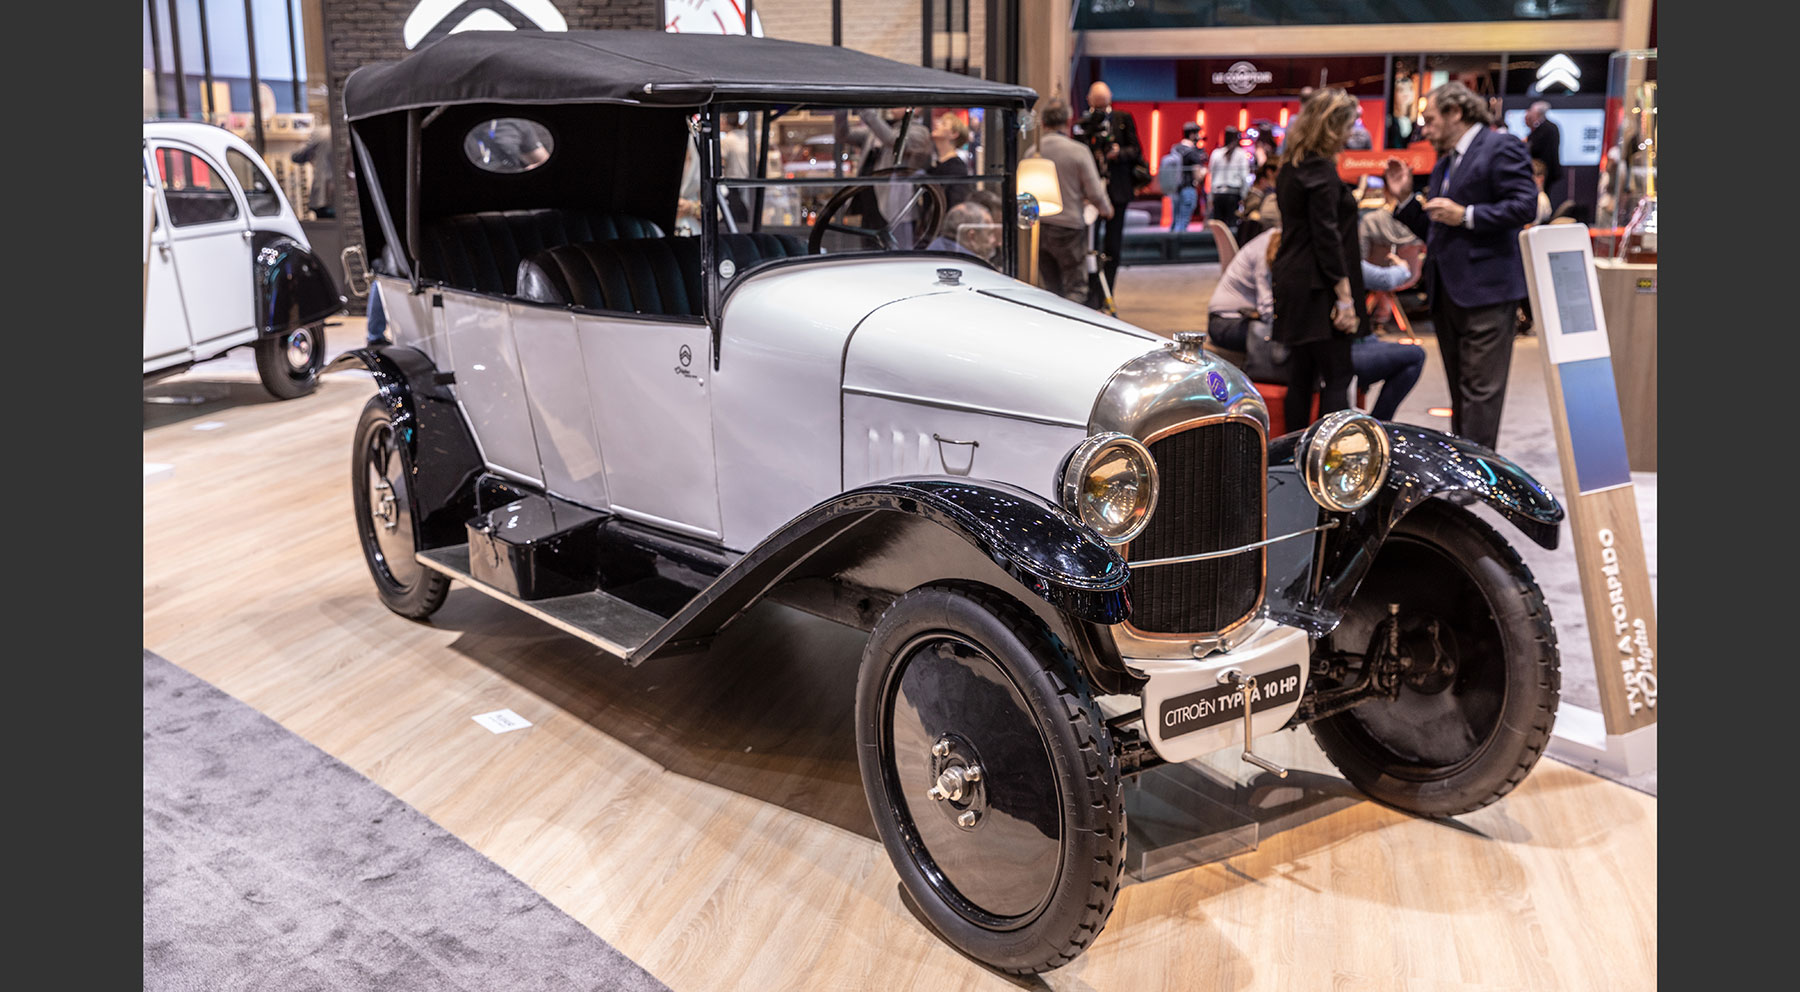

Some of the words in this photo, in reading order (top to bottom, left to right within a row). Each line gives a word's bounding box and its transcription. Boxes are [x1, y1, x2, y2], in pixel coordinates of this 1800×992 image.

[1618, 635, 1633, 655] A
[1165, 698, 1216, 727] CITROËN
[1250, 687, 1261, 703] A
[1264, 682, 1278, 699] 10
[1280, 676, 1298, 695] HP
[1621, 657, 1642, 716] TYPE
